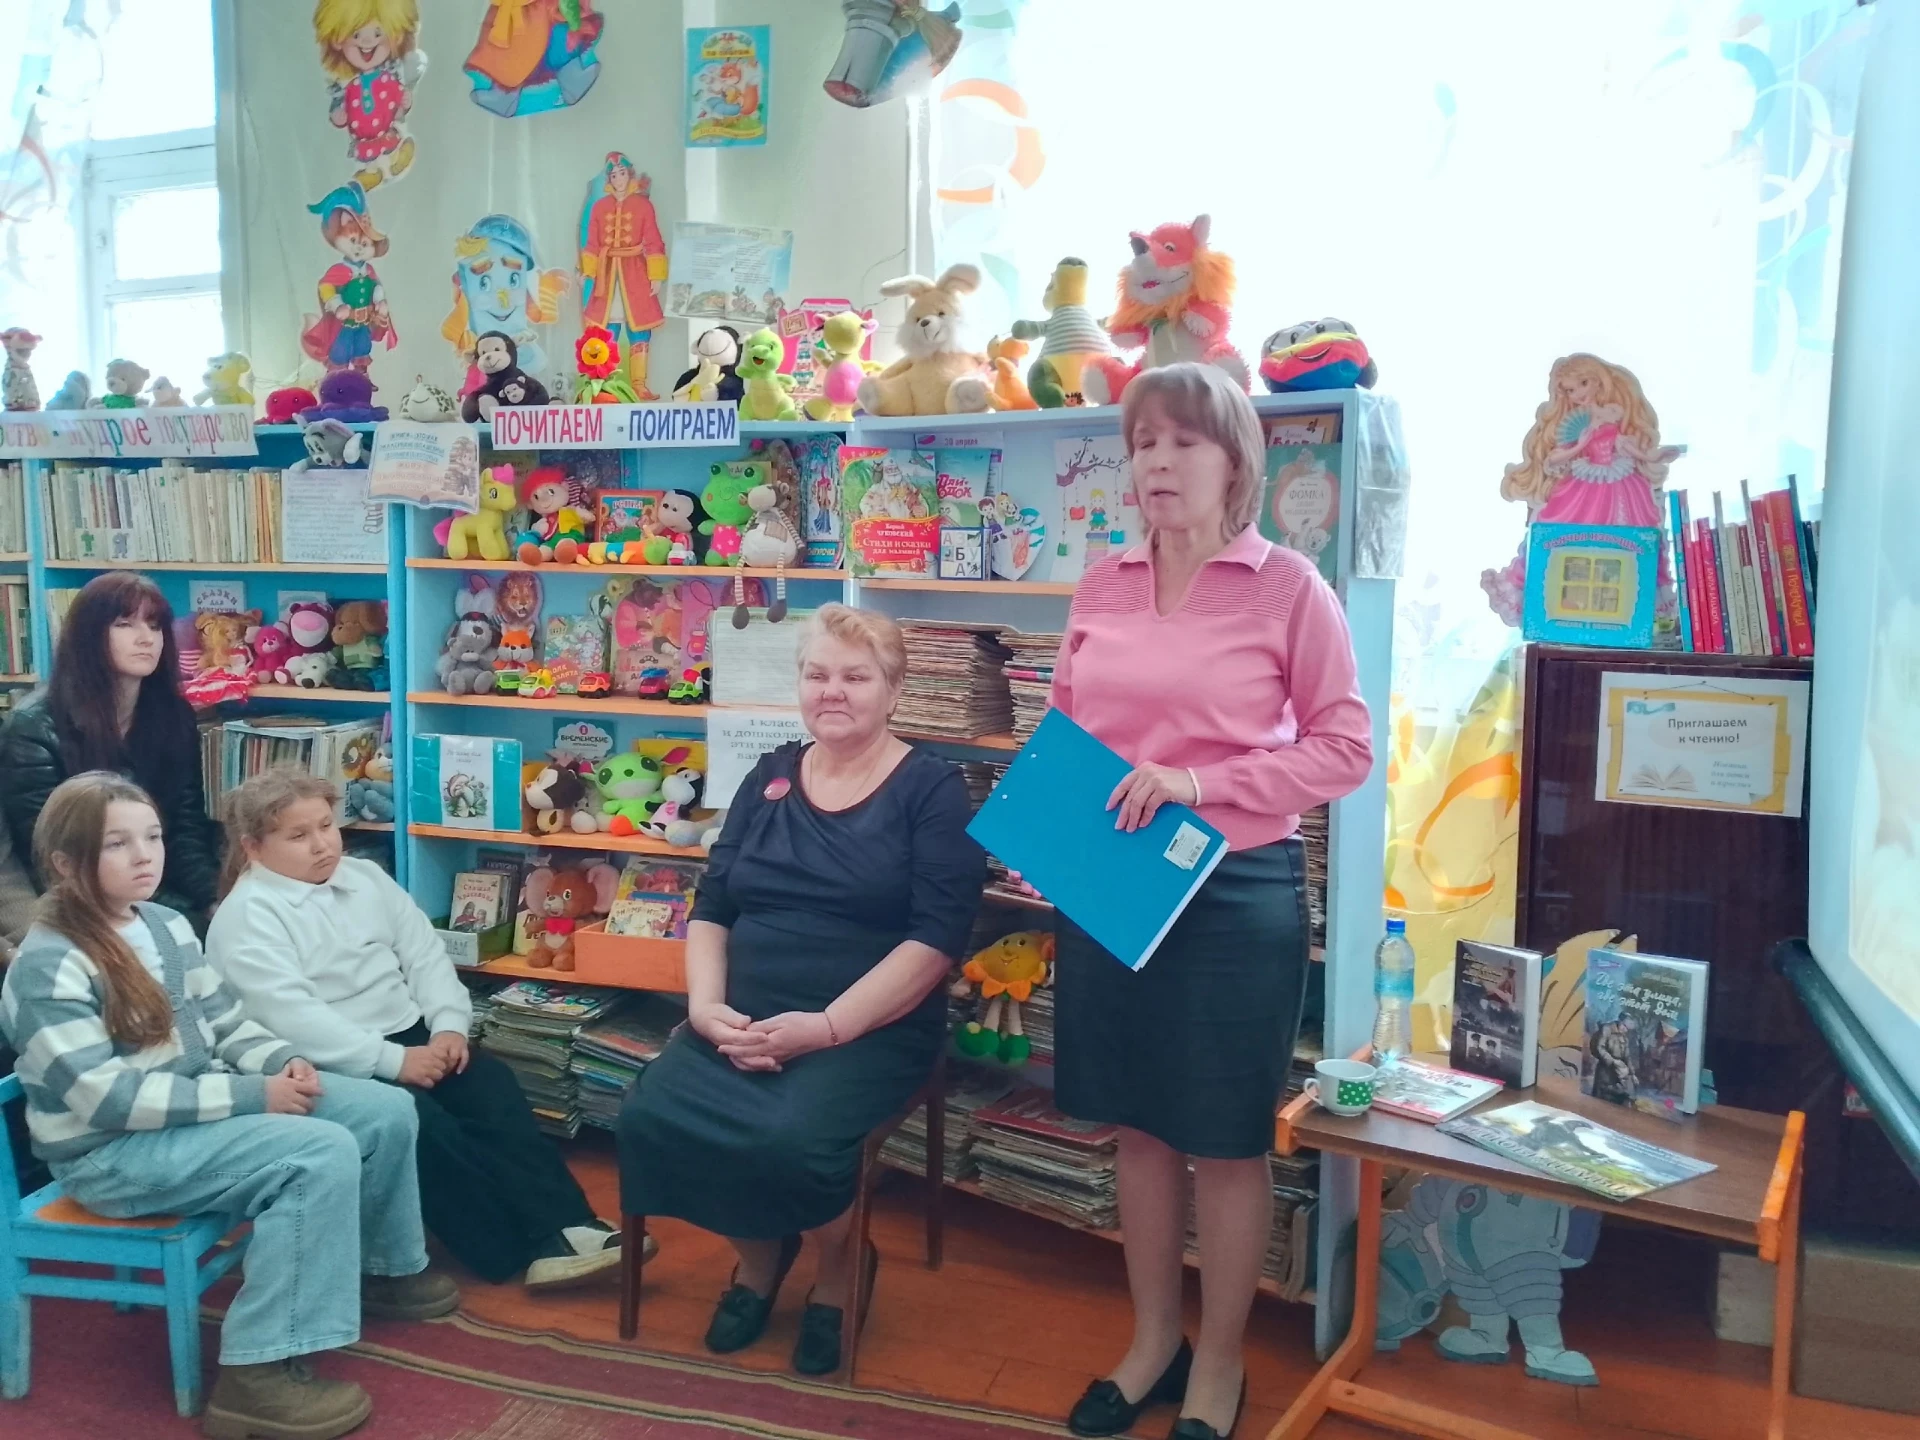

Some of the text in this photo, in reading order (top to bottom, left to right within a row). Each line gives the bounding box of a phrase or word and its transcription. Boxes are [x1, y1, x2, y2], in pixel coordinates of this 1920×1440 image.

[494, 408, 603, 445] ПОЧИТАЕМ
[629, 407, 735, 441] ПОИГРАЕМ
[1289, 489, 1325, 500] ФОМКА
[196, 588, 239, 606] СКАЗКИ
[760, 719, 799, 728] класс
[1667, 718, 1748, 730] Приглашаем
[560, 734, 609, 744] БРЕМЕНСКИЕ
[734, 730, 813, 740] дошколята
[1688, 732, 1741, 744] чтению!
[731, 741, 754, 749] эти
[1617, 982, 1642, 997] эта
